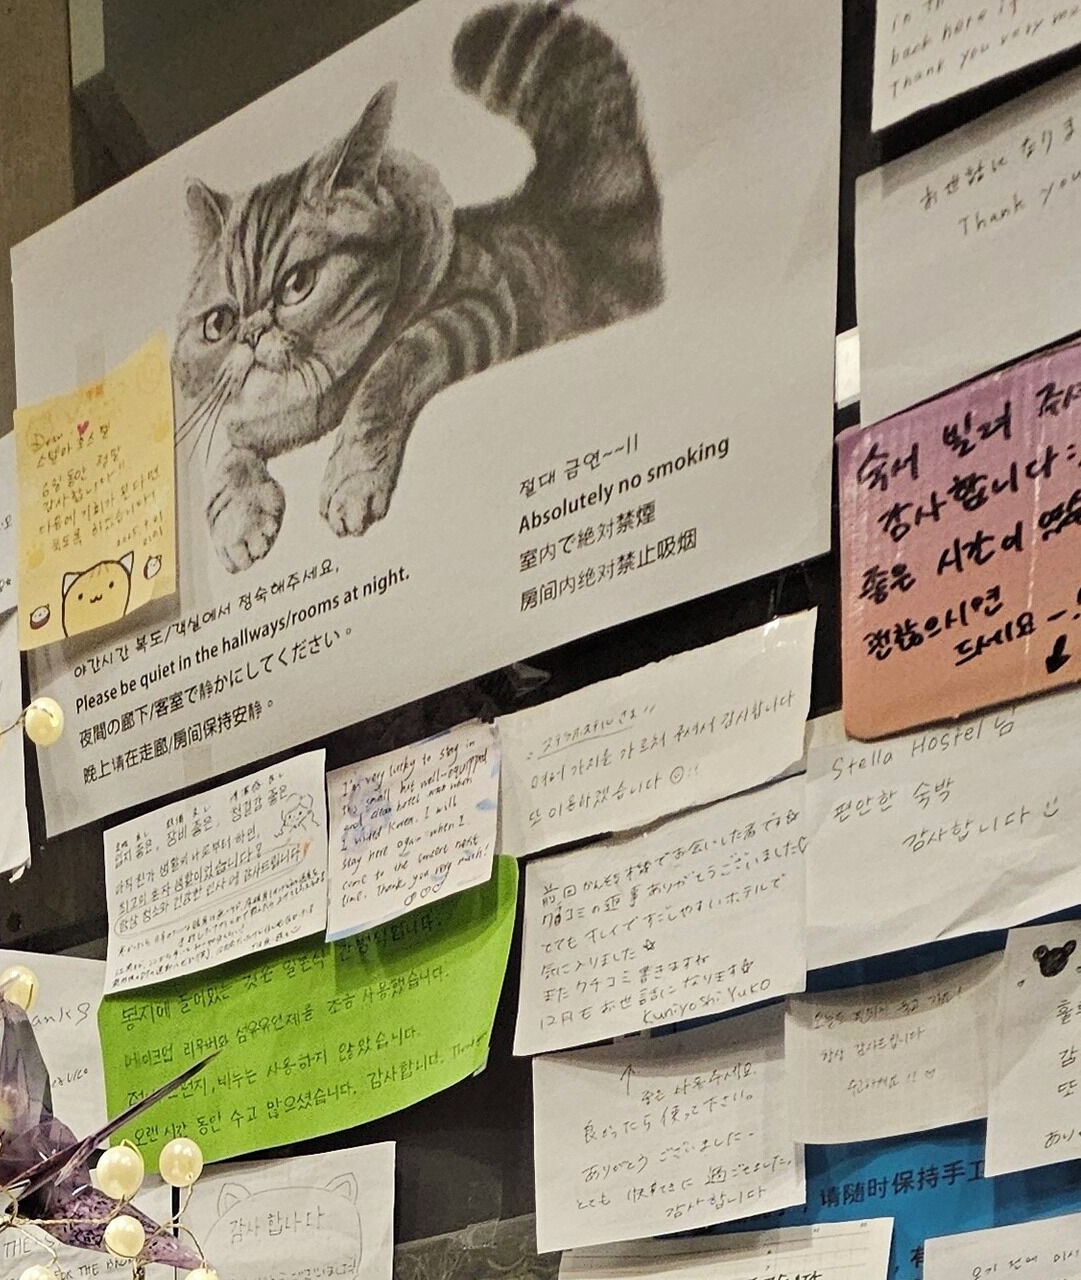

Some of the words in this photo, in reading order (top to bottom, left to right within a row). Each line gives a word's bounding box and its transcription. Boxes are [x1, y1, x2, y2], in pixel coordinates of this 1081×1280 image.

[958, 193, 1025, 235] Thank
[519, 484, 613, 534] Absolutely
[618, 474, 641, 494] no
[647, 438, 730, 483] smoking
[520, 470, 555, 498] 절대
[520, 500, 656, 572] 室内で絶対禁煙
[520, 528, 697, 612] 房间内绝对禁止吸烟
[73, 645, 129, 678] 야간시간
[135, 604, 231, 652] 복도/객실에서
[75, 684, 117, 714] Please
[120, 676, 137, 696] be
[141, 660, 175, 691] quiet
[179, 654, 192, 673] in
[195, 645, 218, 667] the
[222, 595, 339, 654] hallways/rooms
[344, 588, 359, 605] at
[362, 566, 410, 601] night.
[832, 749, 893, 780] Stella
[912, 719, 983, 757] Hostel
[833, 789, 897, 823] 편안한
[912, 777, 955, 809] 숙박
[902, 805, 1030, 852] 감사합니다
